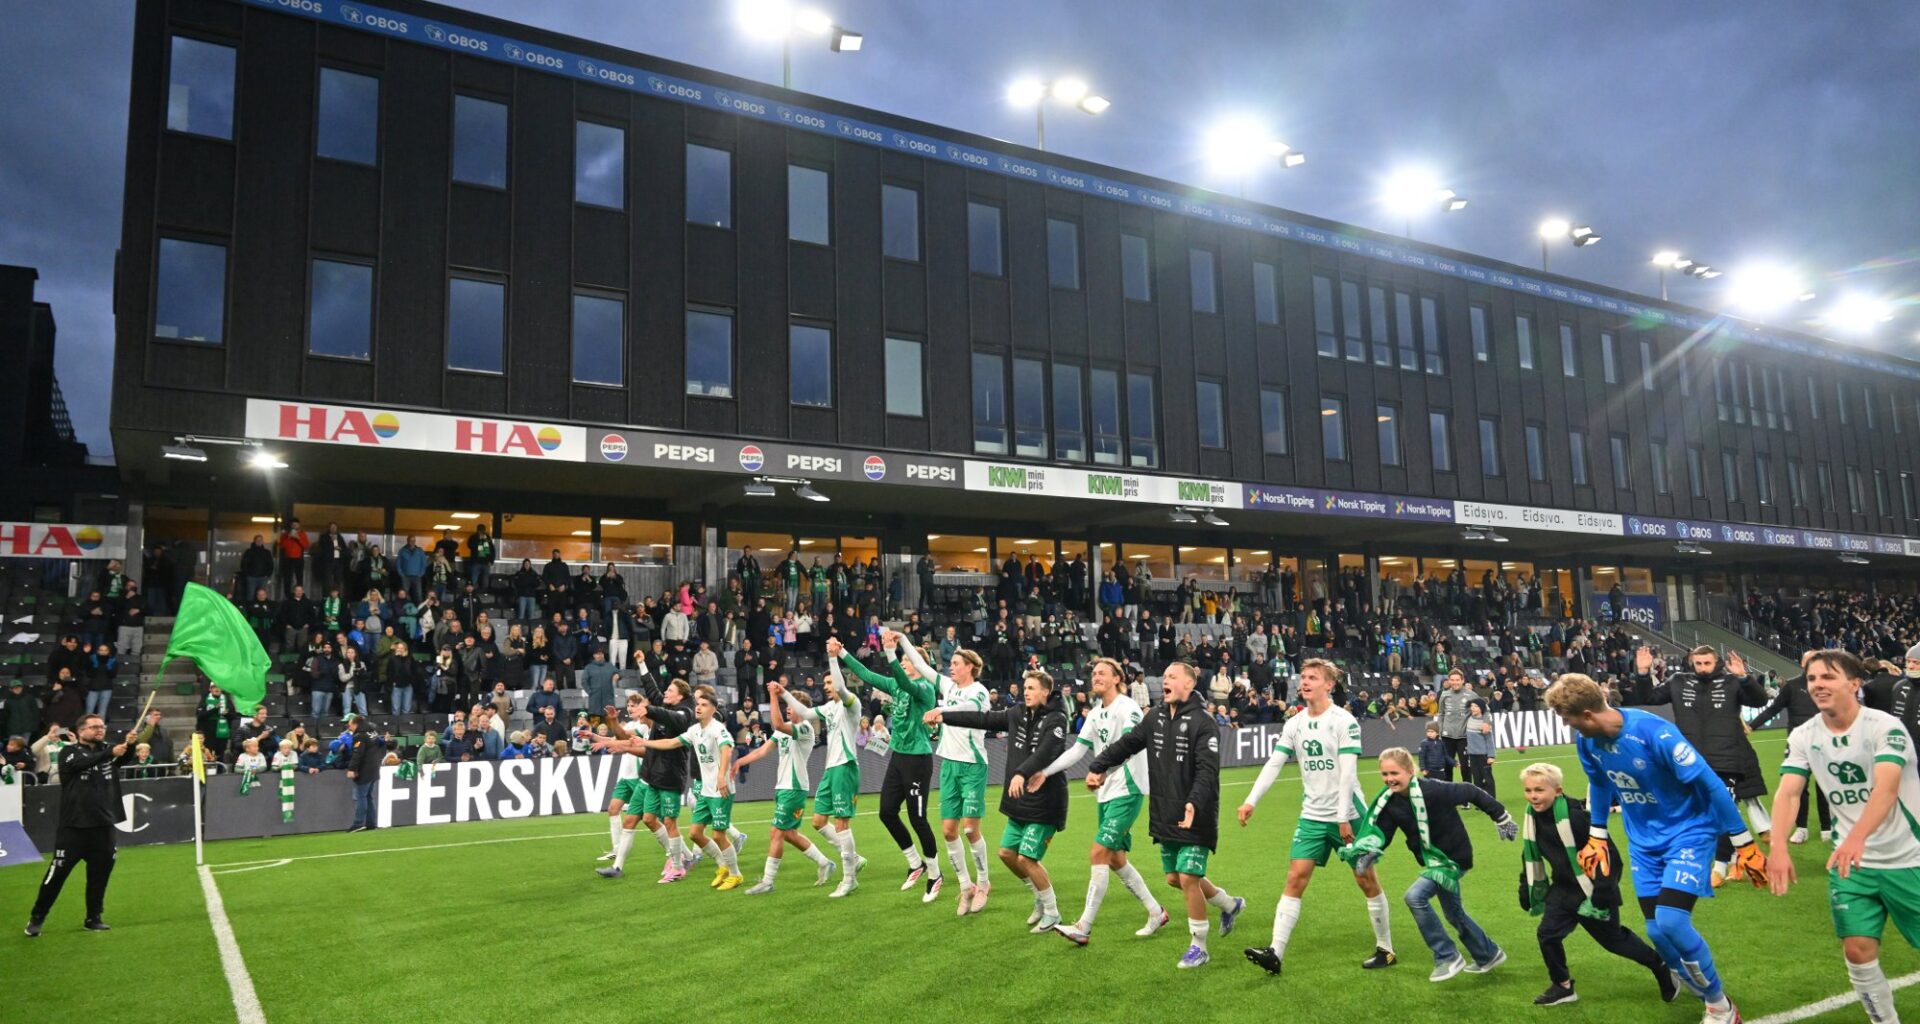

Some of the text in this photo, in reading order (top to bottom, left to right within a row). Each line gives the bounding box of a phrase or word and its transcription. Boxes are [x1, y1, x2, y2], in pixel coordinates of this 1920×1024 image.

[366, 15, 408, 34] OBOS
[448, 34, 488, 51] OBOS
[526, 52, 564, 68] OBOS
[599, 68, 634, 85] OBOS
[668, 85, 702, 100] OBOS
[733, 100, 765, 114] OBOS
[795, 114, 825, 128] OBOS
[854, 128, 882, 141] OBOS
[909, 140, 936, 154] OBOS
[962, 152, 988, 166] OBOS
[1012, 164, 1038, 177] OBOS
[1061, 176, 1084, 188] OBOS
[1106, 185, 1129, 198] OBOS
[1150, 196, 1171, 207] OBOS
[602, 442, 626, 452] PEPSI
[654, 443, 714, 463] PEPSI
[740, 453, 762, 463] PEPSI
[788, 454, 842, 472] PEPSI
[864, 463, 885, 472] PEPSI
[906, 463, 956, 480] PEPSI
[988, 466, 1026, 488] KIWI
[1028, 470, 1044, 481] mini
[1028, 480, 1043, 491] pris
[1088, 474, 1122, 495] KIWI
[1124, 477, 1138, 488] mini
[1211, 484, 1224, 494] mini
[1124, 486, 1138, 498] pris
[1178, 481, 1210, 501] KIWI
[1211, 493, 1224, 503] pris
[1262, 493, 1314, 508] Norsk Tipping
[1338, 499, 1386, 513] Norsk Tipping
[1407, 504, 1451, 518] Norsk Tipping
[1642, 524, 1666, 535] OBOS
[1690, 527, 1712, 538] OBOS
[1734, 531, 1755, 542] OBOS
[1775, 534, 1795, 544] OBOS
[1814, 536, 1833, 547] OBOS
[1621, 607, 1654, 623] OBOS
[1304, 759, 1334, 771] OBOS
[1618, 792, 1658, 804] BOS
[1828, 787, 1874, 805] OBO
[1675, 870, 1688, 885] 12
